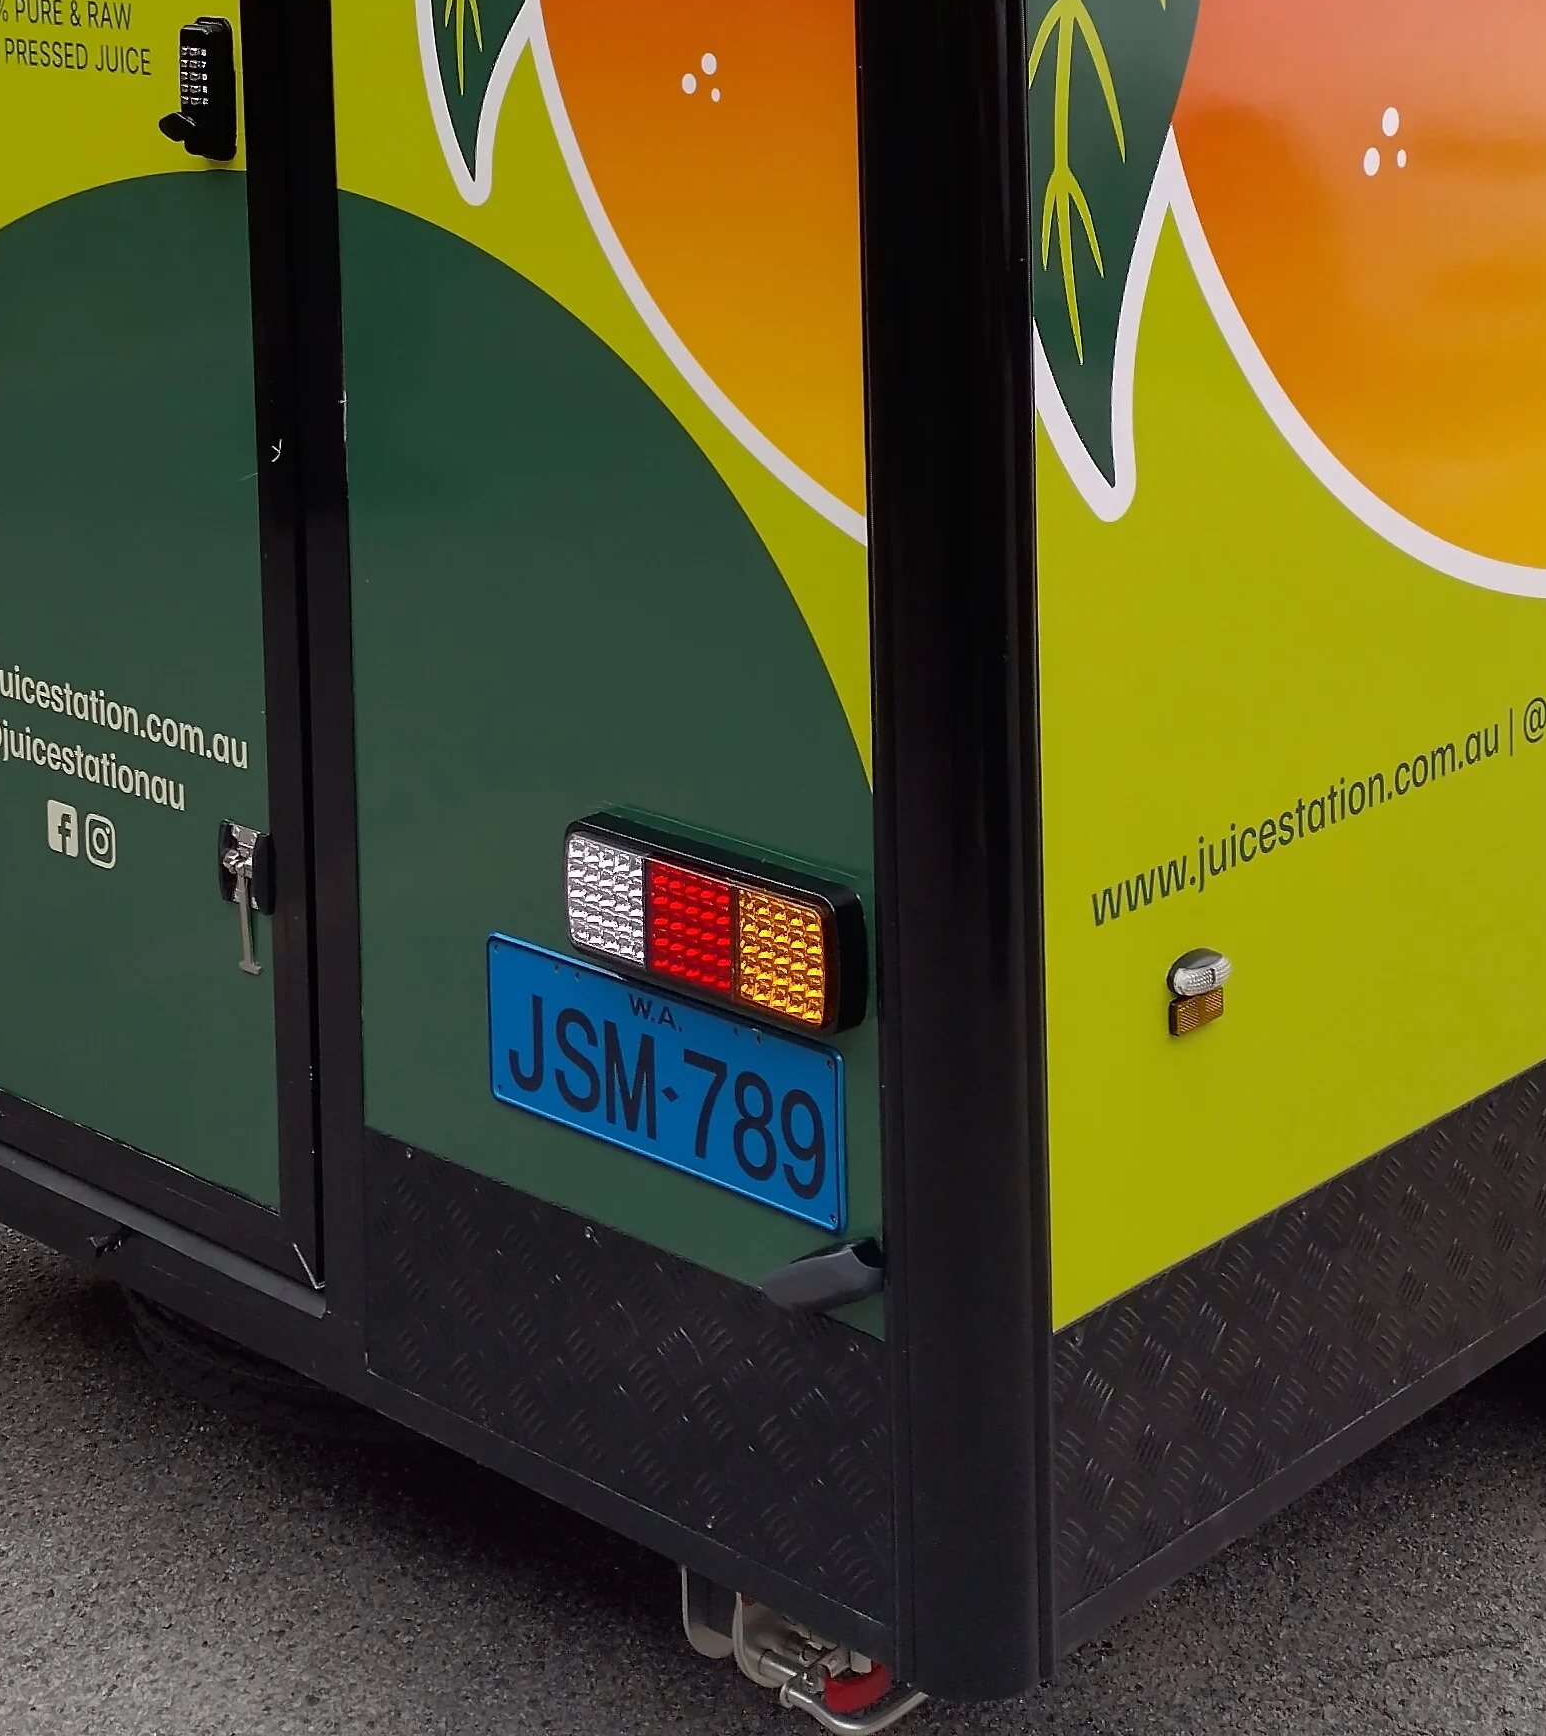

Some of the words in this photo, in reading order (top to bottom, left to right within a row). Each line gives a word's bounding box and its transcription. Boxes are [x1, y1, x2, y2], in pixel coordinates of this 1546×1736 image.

[86, 0, 134, 32] RAW
[4, 35, 91, 70] PRESSED
[94, 42, 154, 77] JUICE
[1089, 718, 1502, 927] www.juicestation.com.au
[627, 991, 684, 1034] W.A.
